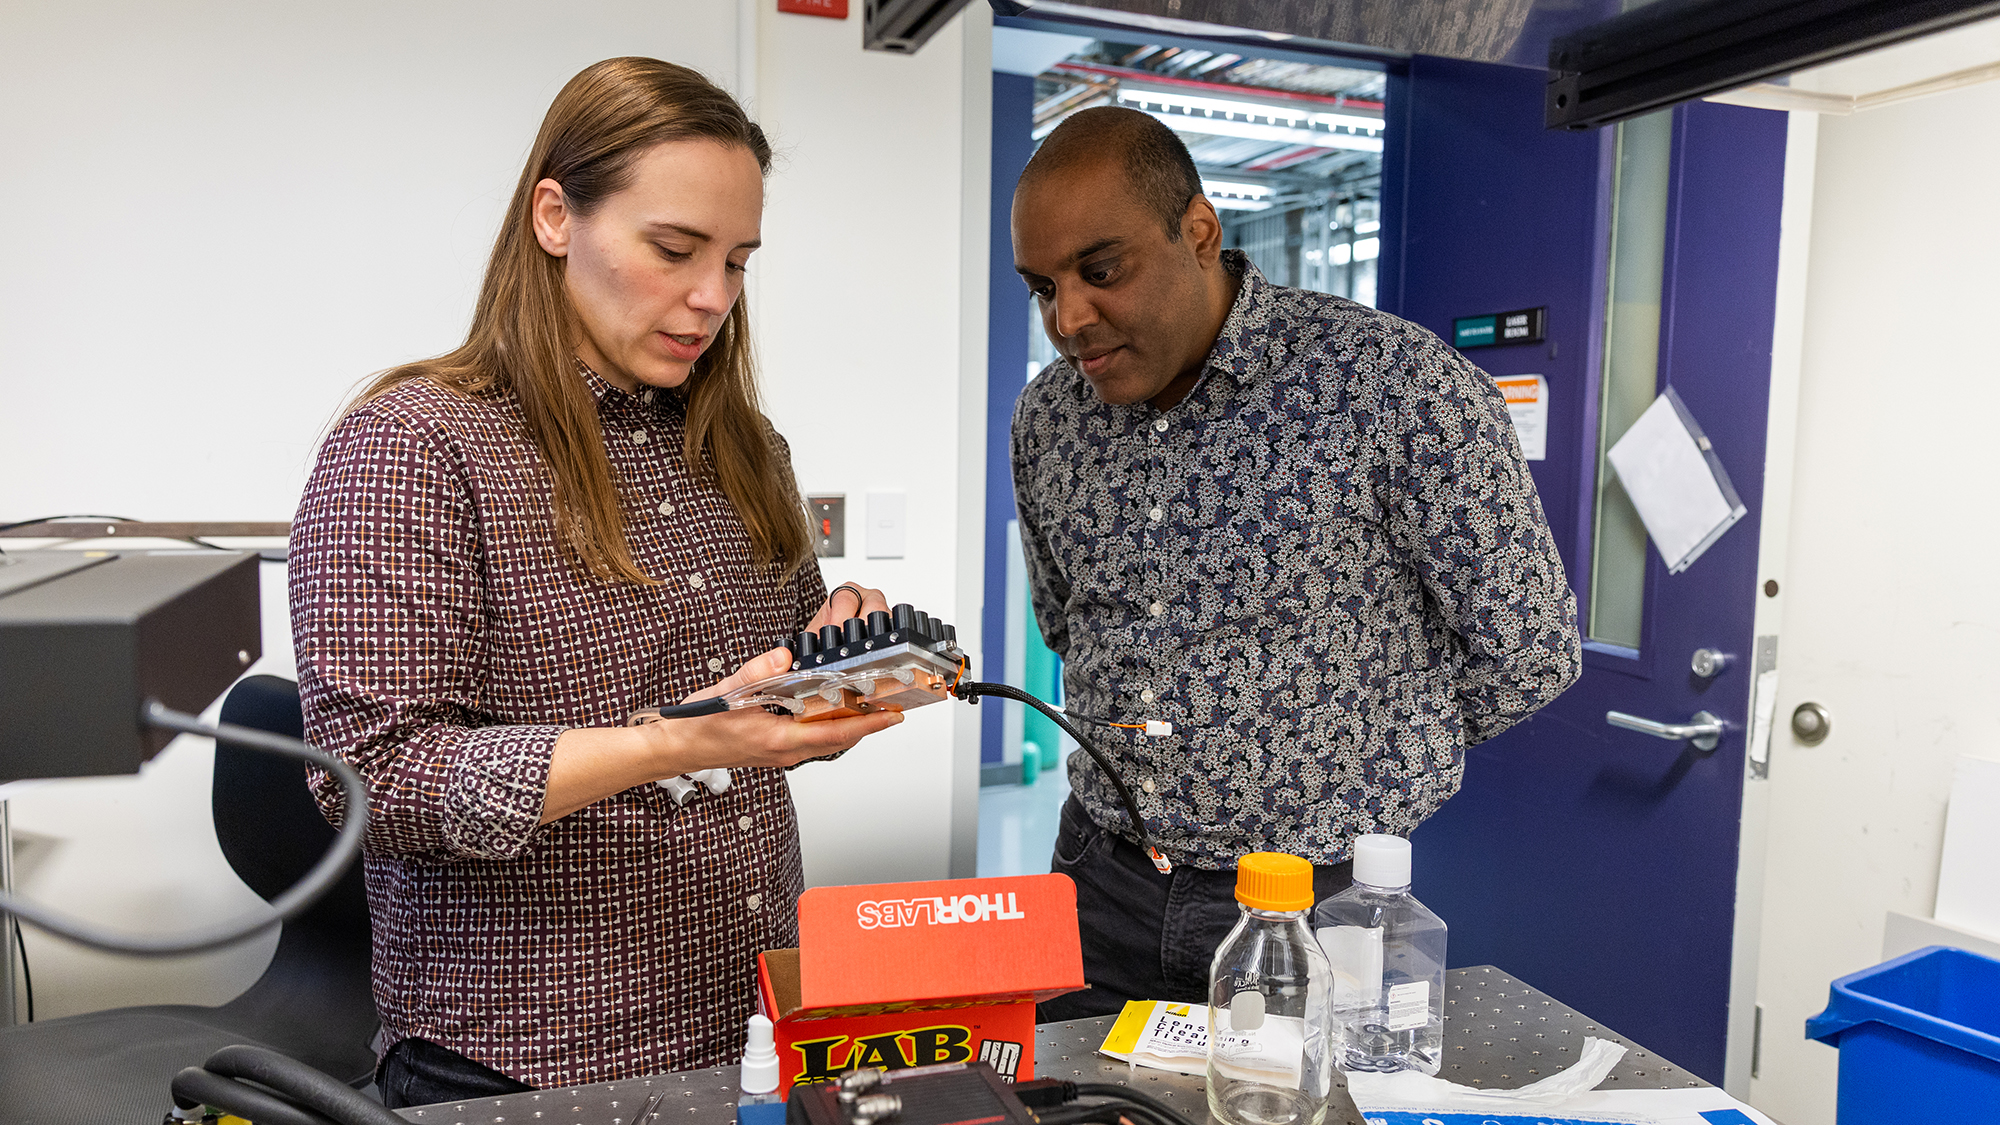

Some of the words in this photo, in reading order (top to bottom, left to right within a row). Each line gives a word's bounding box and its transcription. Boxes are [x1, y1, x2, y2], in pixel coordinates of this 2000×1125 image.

[1502, 384, 1539, 400] ARNING
[857, 892, 1025, 930] THORLABS
[1160, 1016, 1206, 1032] Lens
[791, 1024, 974, 1082] LAB
